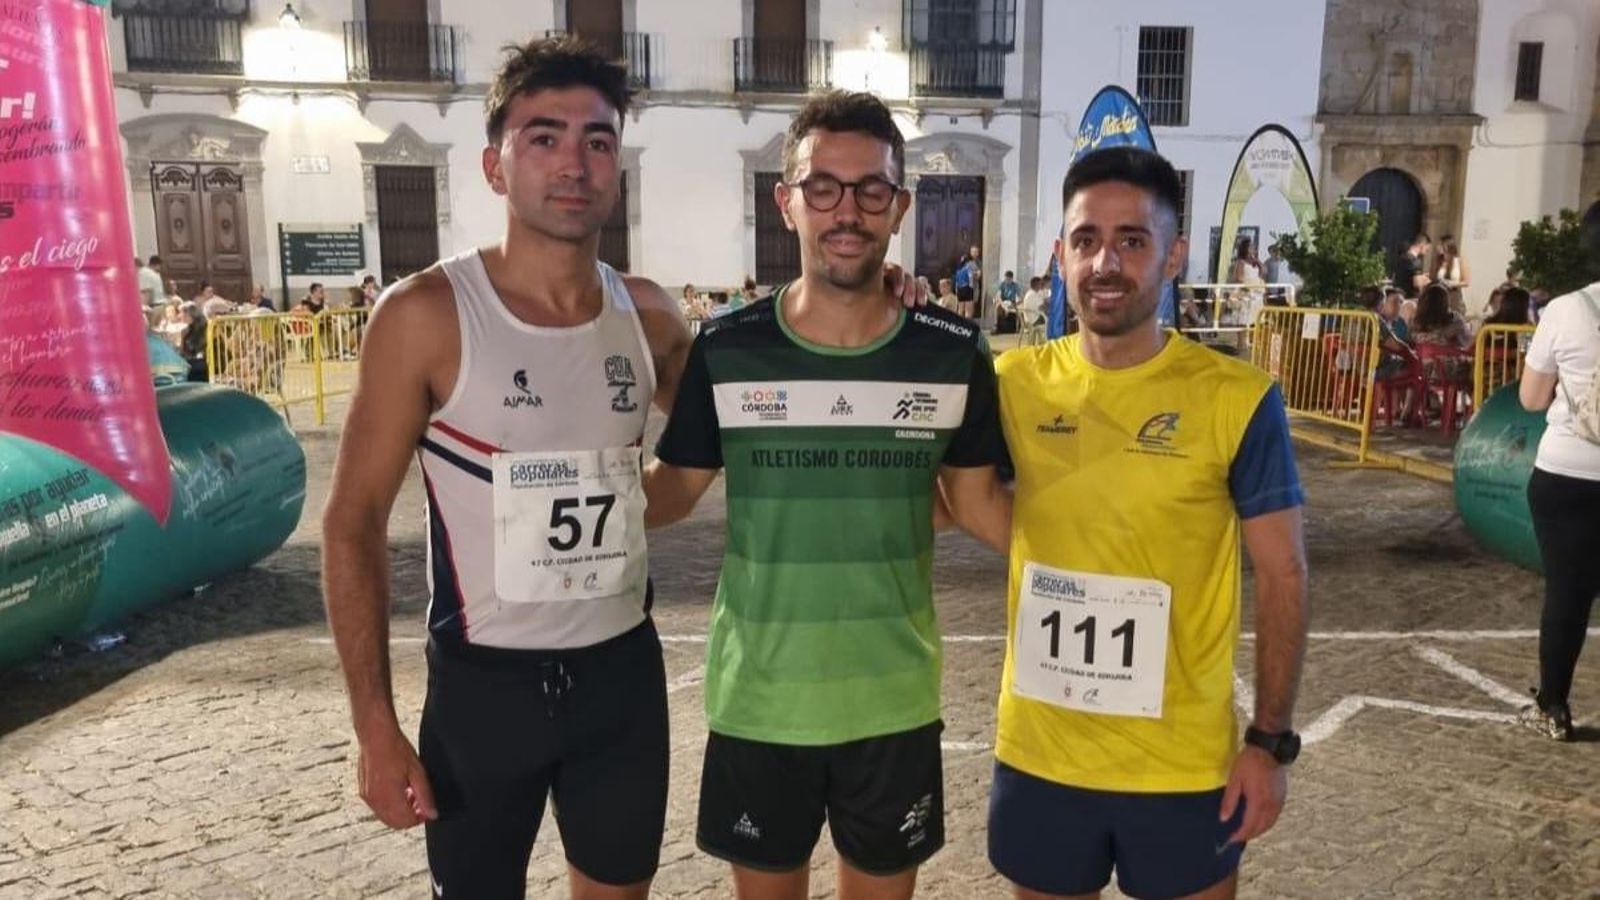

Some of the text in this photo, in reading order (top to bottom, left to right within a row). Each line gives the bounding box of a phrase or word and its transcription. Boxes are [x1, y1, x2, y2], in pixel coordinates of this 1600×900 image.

[19, 236, 43, 269] el
[48, 236, 98, 270] ciego
[913, 312, 973, 338] DECATHLON
[751, 449, 839, 468] ATLETISMO
[510, 469, 579, 483] populares
[69, 493, 108, 523] planeta
[547, 494, 616, 551] 57
[1041, 610, 1135, 667] 111
